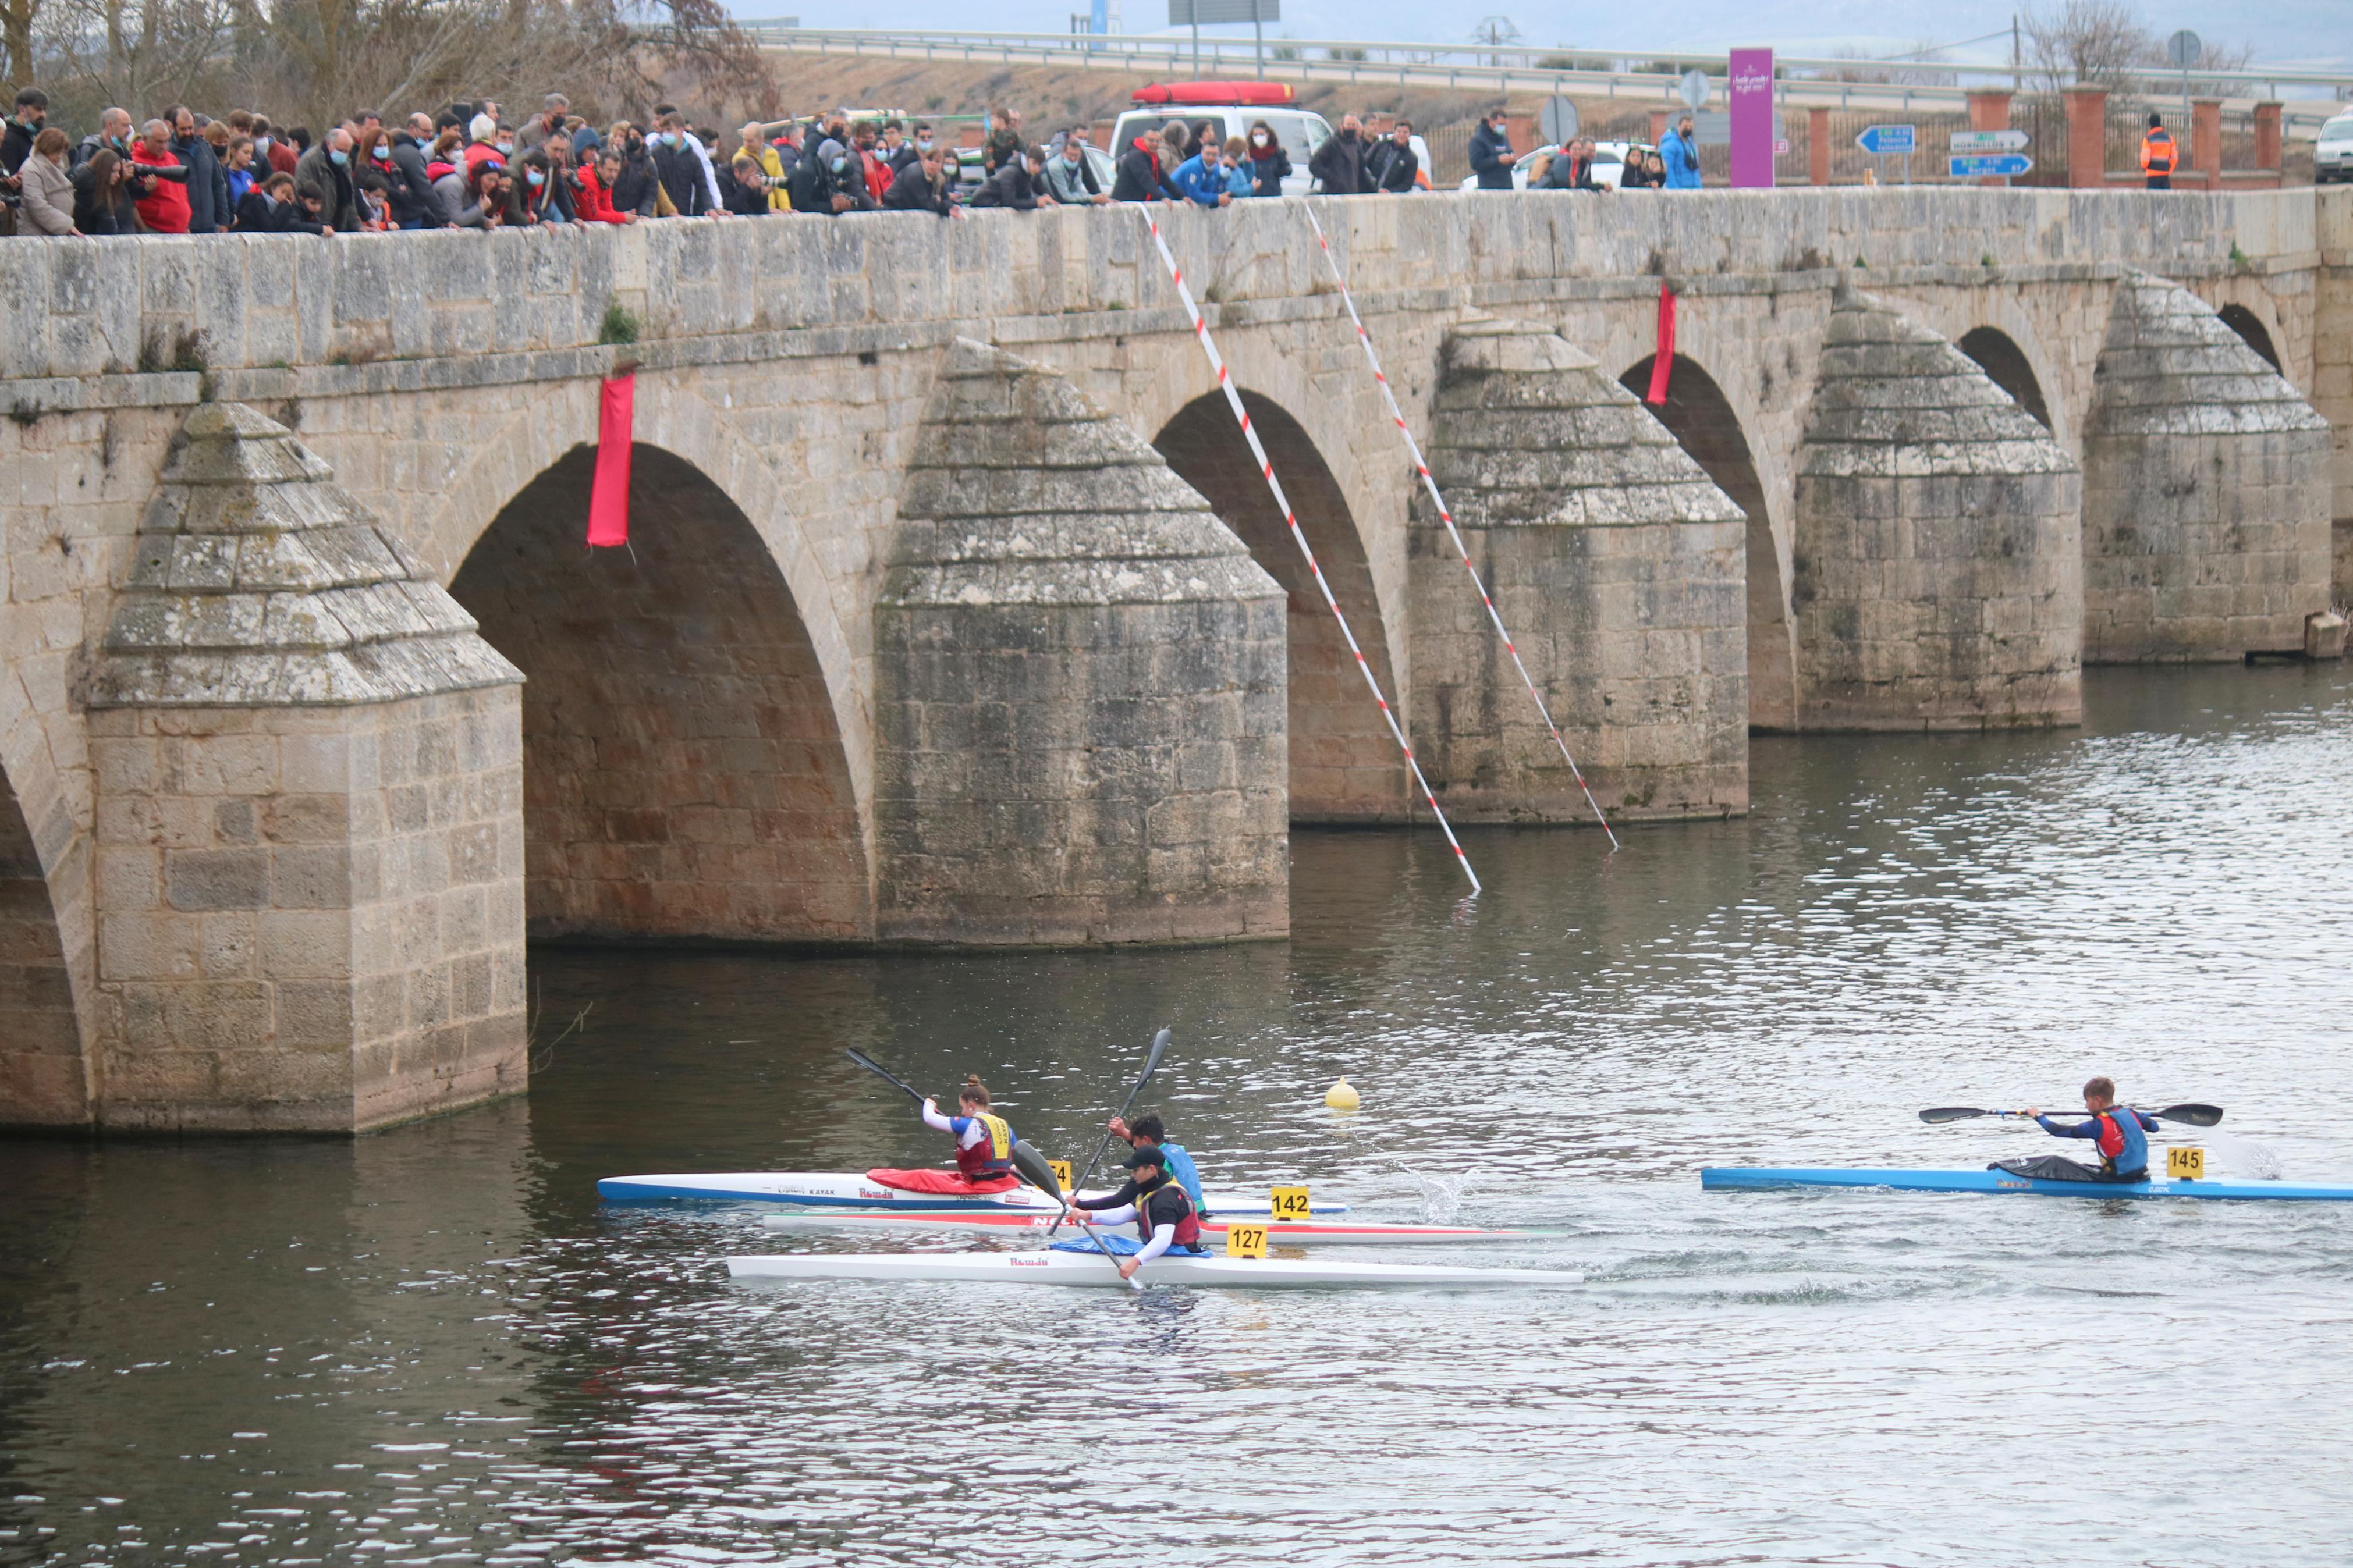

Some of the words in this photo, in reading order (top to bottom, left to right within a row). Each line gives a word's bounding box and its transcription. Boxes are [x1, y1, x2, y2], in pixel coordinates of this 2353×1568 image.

[1953, 140, 2004, 149] HORNILLOS
[1968, 166, 1996, 175] Burgos
[2171, 1150, 2199, 1169] 145
[1272, 1195, 1308, 1212] 142
[1233, 1229, 1262, 1249] 127
